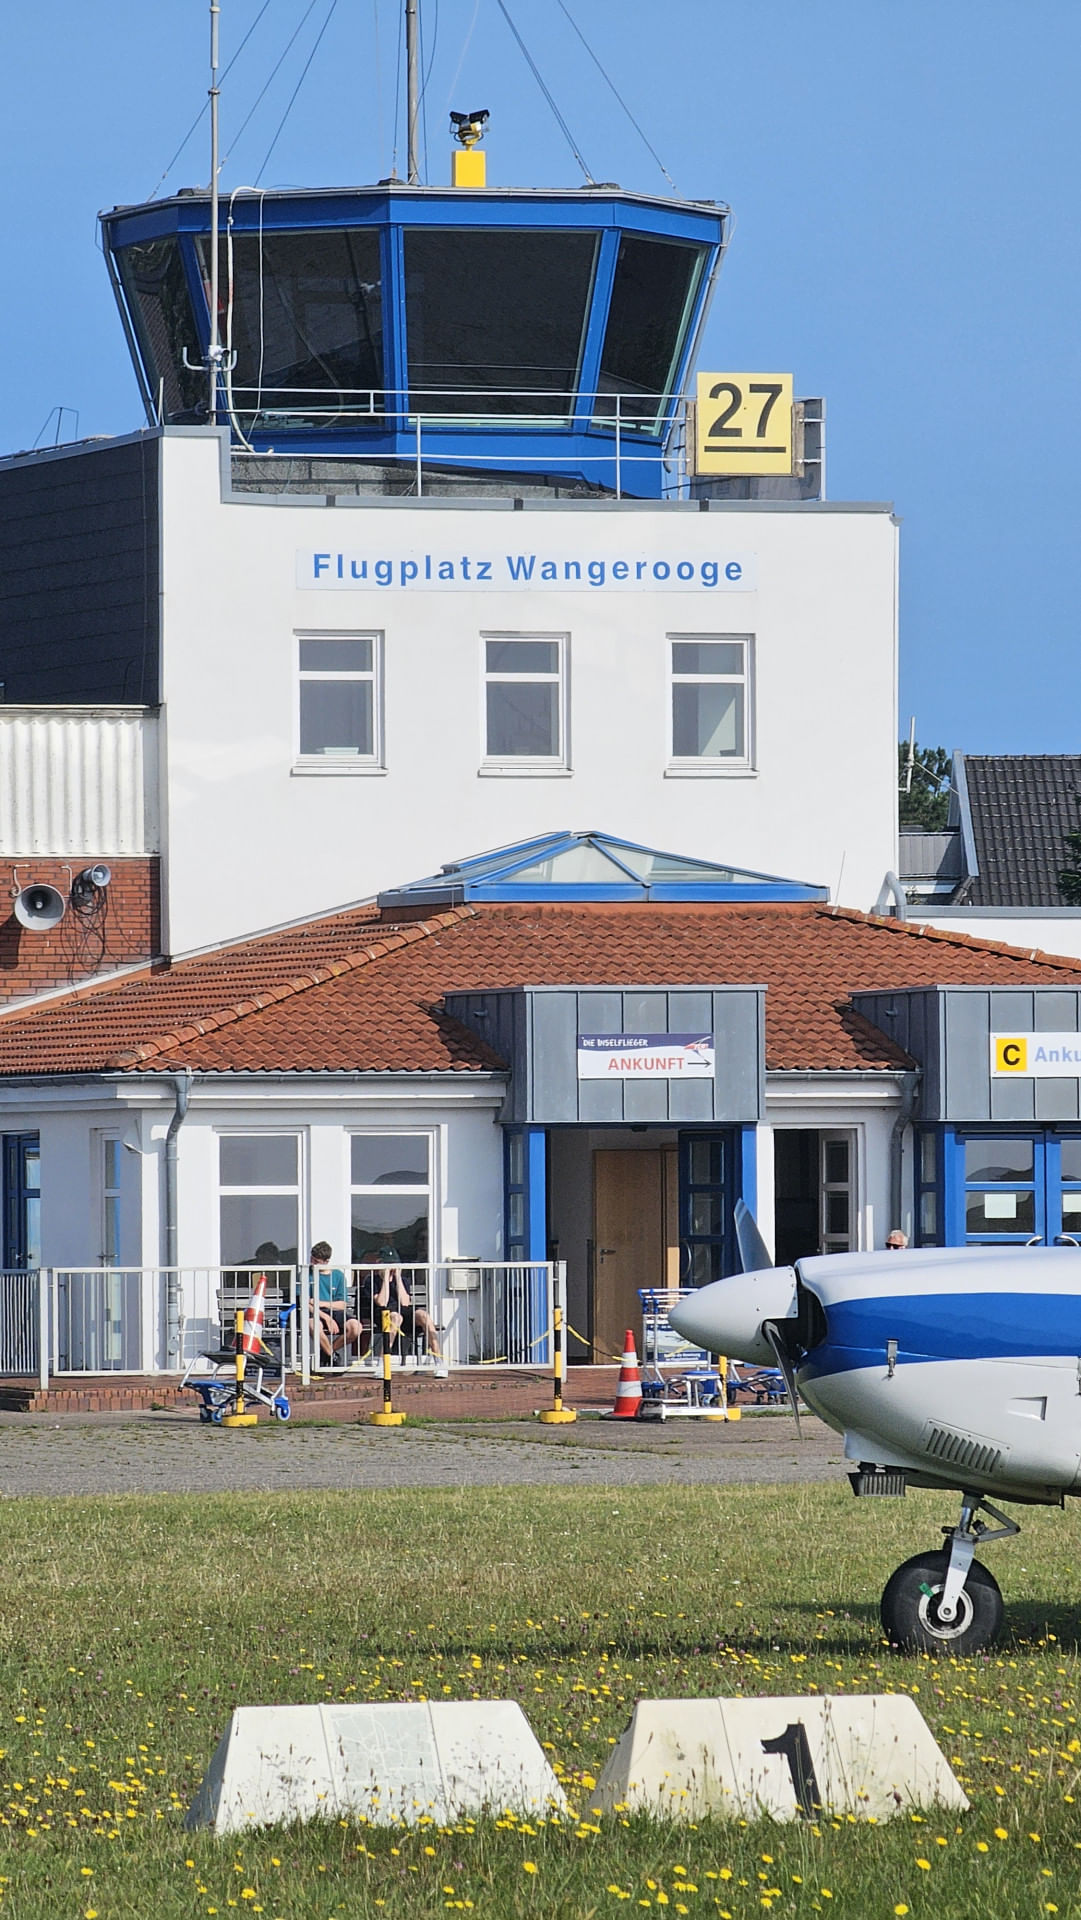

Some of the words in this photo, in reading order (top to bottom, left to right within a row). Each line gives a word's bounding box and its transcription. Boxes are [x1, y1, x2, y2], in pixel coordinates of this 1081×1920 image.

[708, 382, 783, 438] 27
[313, 553, 493, 587] Flugplatz
[506, 555, 743, 587] Wangerooge
[582, 1038, 596, 1047] DIE
[1003, 1044, 1021, 1066] C
[607, 1057, 685, 1071] ANKUNFT
[760, 1723, 823, 1820] 1
